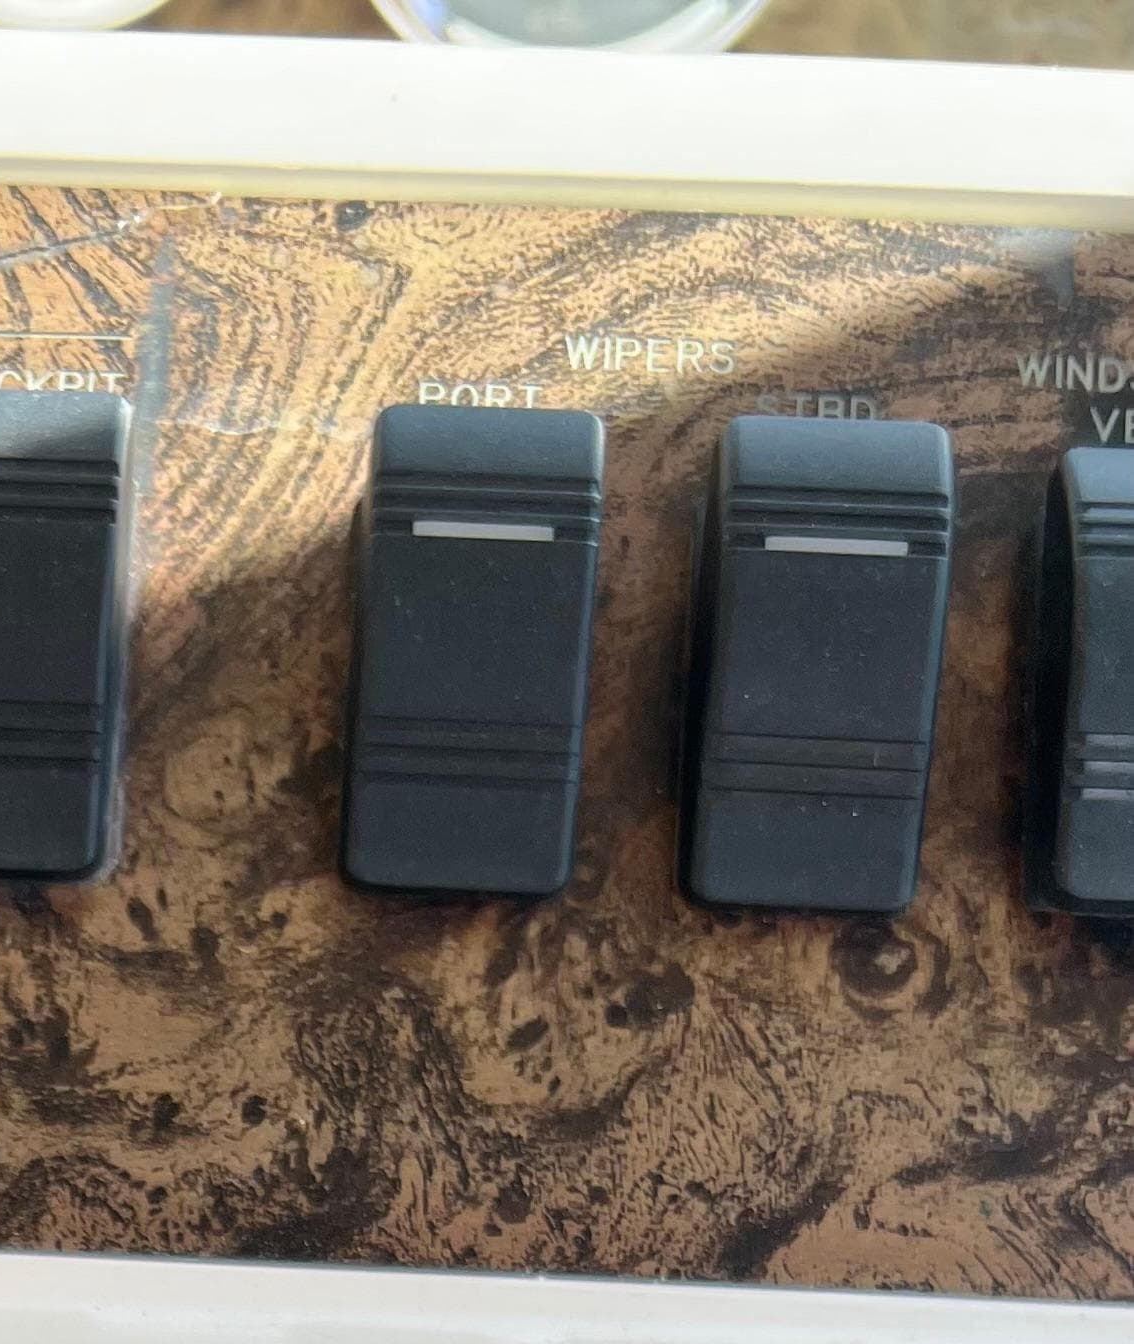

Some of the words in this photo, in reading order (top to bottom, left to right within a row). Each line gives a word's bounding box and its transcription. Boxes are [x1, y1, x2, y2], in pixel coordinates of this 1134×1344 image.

[564, 334, 736, 375] WIPERS
[1015, 351, 1134, 393] WIND
[418, 381, 543, 409] PORT
